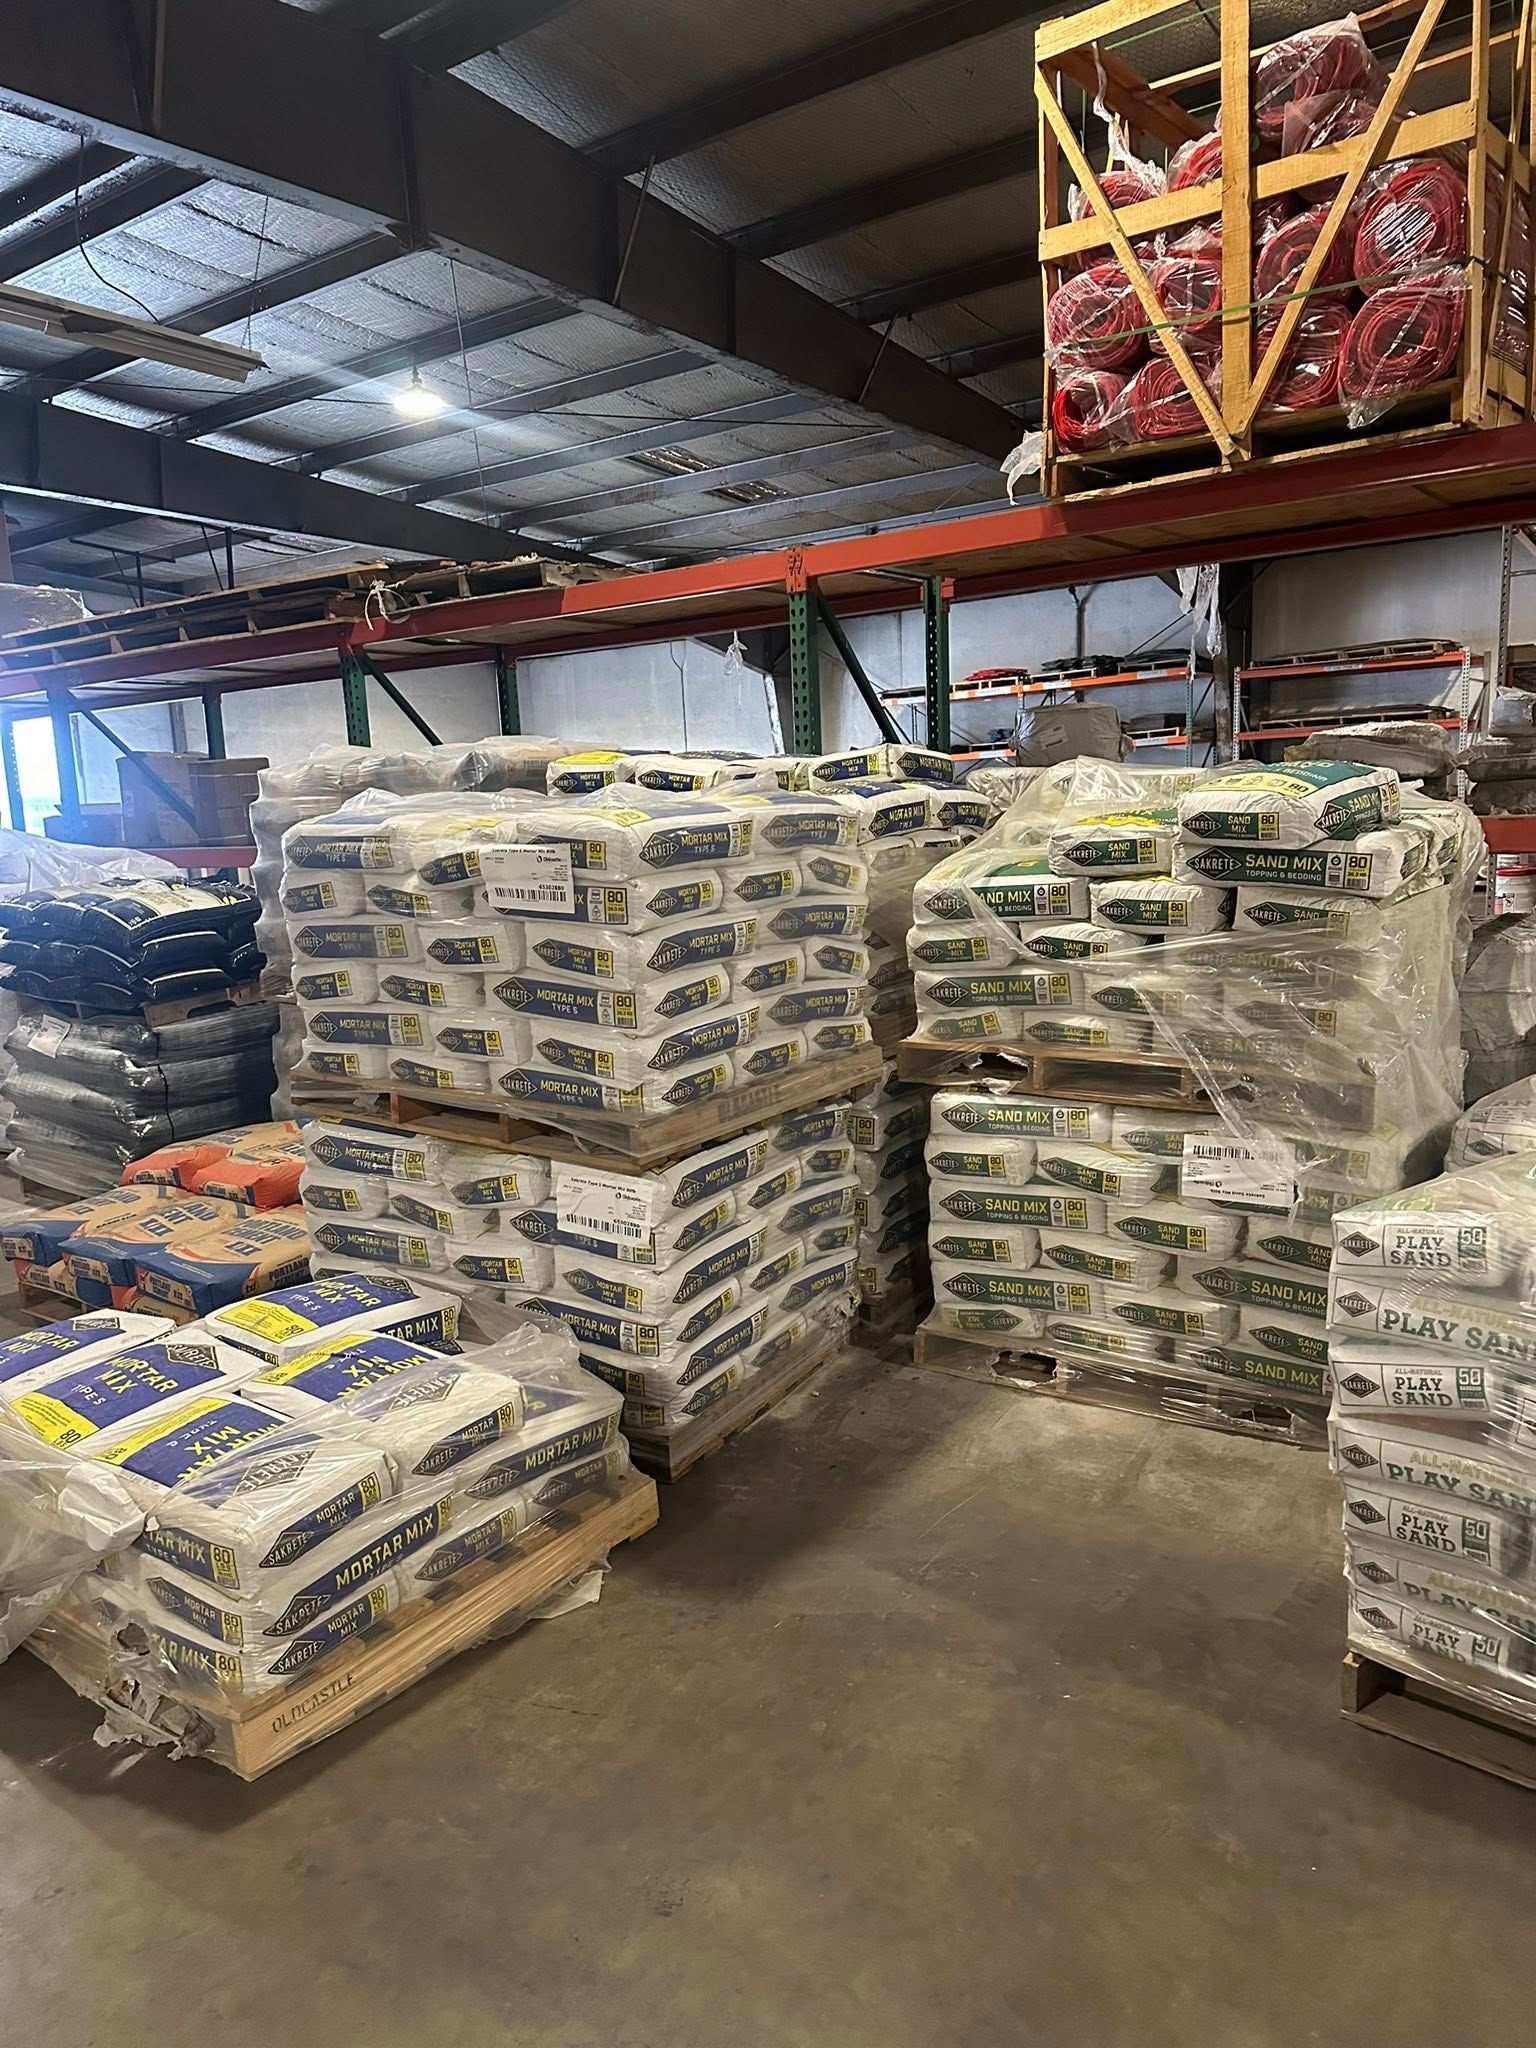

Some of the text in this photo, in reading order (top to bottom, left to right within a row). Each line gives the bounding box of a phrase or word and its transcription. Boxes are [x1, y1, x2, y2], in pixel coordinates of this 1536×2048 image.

[842, 758, 864, 767] MORTAR
[919, 757, 942, 769] MORTAR
[668, 774, 690, 782] MORTAR
[1288, 783, 1309, 793] 80
[1187, 819, 1217, 831] SAKRETE
[1227, 815, 1250, 825] SAND
[1321, 809, 1348, 829] SAKRETE
[1194, 856, 1236, 871] SAKRETE
[1245, 854, 1323, 872] SAND MIX
[1348, 856, 1368, 868] 80
[1246, 870, 1322, 881] TOPPING & BEDDING
[608, 891, 624, 903] 80
[1051, 886, 1066, 897] 80
[1249, 908, 1282, 922] SAKRETE
[1294, 909, 1320, 921] SAND
[970, 980, 1032, 994] SAND MIX
[1052, 976, 1066, 987] 80
[499, 987, 530, 1001] SAKRETE
[536, 989, 594, 1007] MORTAR MIX
[616, 995, 632, 1008] 80
[551, 1003, 578, 1015] TYPE S
[403, 1016, 416, 1027] 80
[691, 1023, 737, 1047] MORTAR MIX
[502, 1079, 533, 1094] SAKRETE
[540, 1080, 599, 1098] MORTAR MIX
[987, 1110, 1050, 1124] SAND MIX
[1070, 1110, 1086, 1121] 80
[408, 1153, 421, 1164] 80
[705, 1157, 748, 1183] MORTAR MIX
[1077, 1167, 1098, 1180] SAND
[1104, 1174, 1118, 1184] 80
[985, 1198, 1048, 1214] SAND MIX
[1067, 1200, 1083, 1211] 80
[986, 1212, 1013, 1220] TOPPING
[1020, 1214, 1049, 1222] BEDDING
[515, 1218, 548, 1234] SAKRETE
[1118, 1222, 1149, 1236] SAKRETE
[1157, 1224, 1180, 1236] SAND
[1189, 1228, 1203, 1238] 80
[1161, 1232, 1177, 1242] MIX
[1396, 1236, 1445, 1250] PLAY
[1460, 1228, 1484, 1246] 50
[1262, 1240, 1296, 1256] SAKRETE
[708, 1247, 749, 1274] MORTAR MIX
[1084, 1254, 1106, 1266] SAND
[1309, 1254, 1328, 1266] MIX
[1390, 1251, 1452, 1268] SAND
[597, 1280, 623, 1293] MORTAR
[950, 1281, 981, 1294] SAKRETE
[989, 1280, 1052, 1298] SAND MIX
[1070, 1286, 1087, 1297] 80
[1200, 1275, 1240, 1293] SAKRETE
[310, 1287, 348, 1305] MIX
[319, 1278, 382, 1307] MORTAR
[627, 1287, 639, 1299] 80
[1250, 1281, 1328, 1307] SAND MIX
[1250, 1294, 1284, 1307] TOPPING
[1292, 1303, 1327, 1316] BEDDING
[1340, 1297, 1372, 1313] SAKRETE
[442, 1307, 455, 1322] 80
[1154, 1309, 1178, 1321] SAND
[1186, 1313, 1200, 1324] 80
[385, 1316, 440, 1341] TAR MIX
[559, 1312, 617, 1336] MORTAR MIX
[17, 1330, 81, 1352] MORTAR
[639, 1327, 655, 1339] 80
[1254, 1330, 1286, 1347] SAKRETE
[1382, 1308, 1459, 1342] PLAY
[1464, 1326, 1536, 1362] SAN
[6, 1341, 43, 1355] MIX
[1297, 1337, 1323, 1351] SAND
[1301, 1346, 1319, 1358] MIX
[103, 1355, 180, 1394] MORTAR
[341, 1355, 390, 1379] MIX
[1244, 1360, 1320, 1387] SAND MIX
[1394, 1367, 1443, 1377] ALL-NATURAL
[94, 1369, 139, 1395] MIX
[336, 1354, 430, 1398] MORTAR
[1395, 1376, 1443, 1392] PLAY
[1459, 1368, 1482, 1386] 50
[1391, 1392, 1453, 1407] SAND
[61, 1429, 82, 1445] 80
[461, 1416, 494, 1442] MORTAR
[184, 1426, 243, 1455] MIX
[525, 1432, 580, 1471] MORTAR
[582, 1424, 605, 1444] MIX
[420, 1447, 454, 1473] SAKRETE
[574, 1461, 602, 1479] MORTAR
[361, 1479, 376, 1496] 80
[476, 1468, 516, 1496] SAKRETE
[1386, 1462, 1536, 1515] PLAY SAN
[316, 1492, 356, 1523] MORTAR
[1402, 1504, 1450, 1523] ALL-NATURAL
[1401, 1512, 1449, 1537] PLAY
[1464, 1518, 1490, 1540] 50
[464, 1521, 498, 1546] MORTAR
[1396, 1526, 1457, 1553] SAND
[149, 1530, 206, 1564] TAR MIX
[268, 1532, 309, 1566] SAKRETE
[336, 1535, 404, 1590] MORTAR
[406, 1512, 435, 1541] MIX
[475, 1538, 491, 1552] MIX
[213, 1546, 231, 1564] 80
[422, 1552, 458, 1577] SAKRETE
[371, 1588, 385, 1604] 80
[1403, 1581, 1478, 1614] PLAY
[184, 1594, 217, 1620] MORTAR
[275, 1594, 325, 1634] SAKRETE
[223, 1614, 240, 1629] 80
[327, 1603, 365, 1634] MORTAR
[339, 1621, 358, 1638] MIX
[1413, 1623, 1461, 1649] PLAY
[1409, 1635, 1466, 1665] SAND
[1474, 1636, 1500, 1659] 50
[218, 1654, 237, 1672] 80
[277, 1641, 320, 1673] SAKRETE
[272, 1675, 356, 1735] OLDCASTLE
